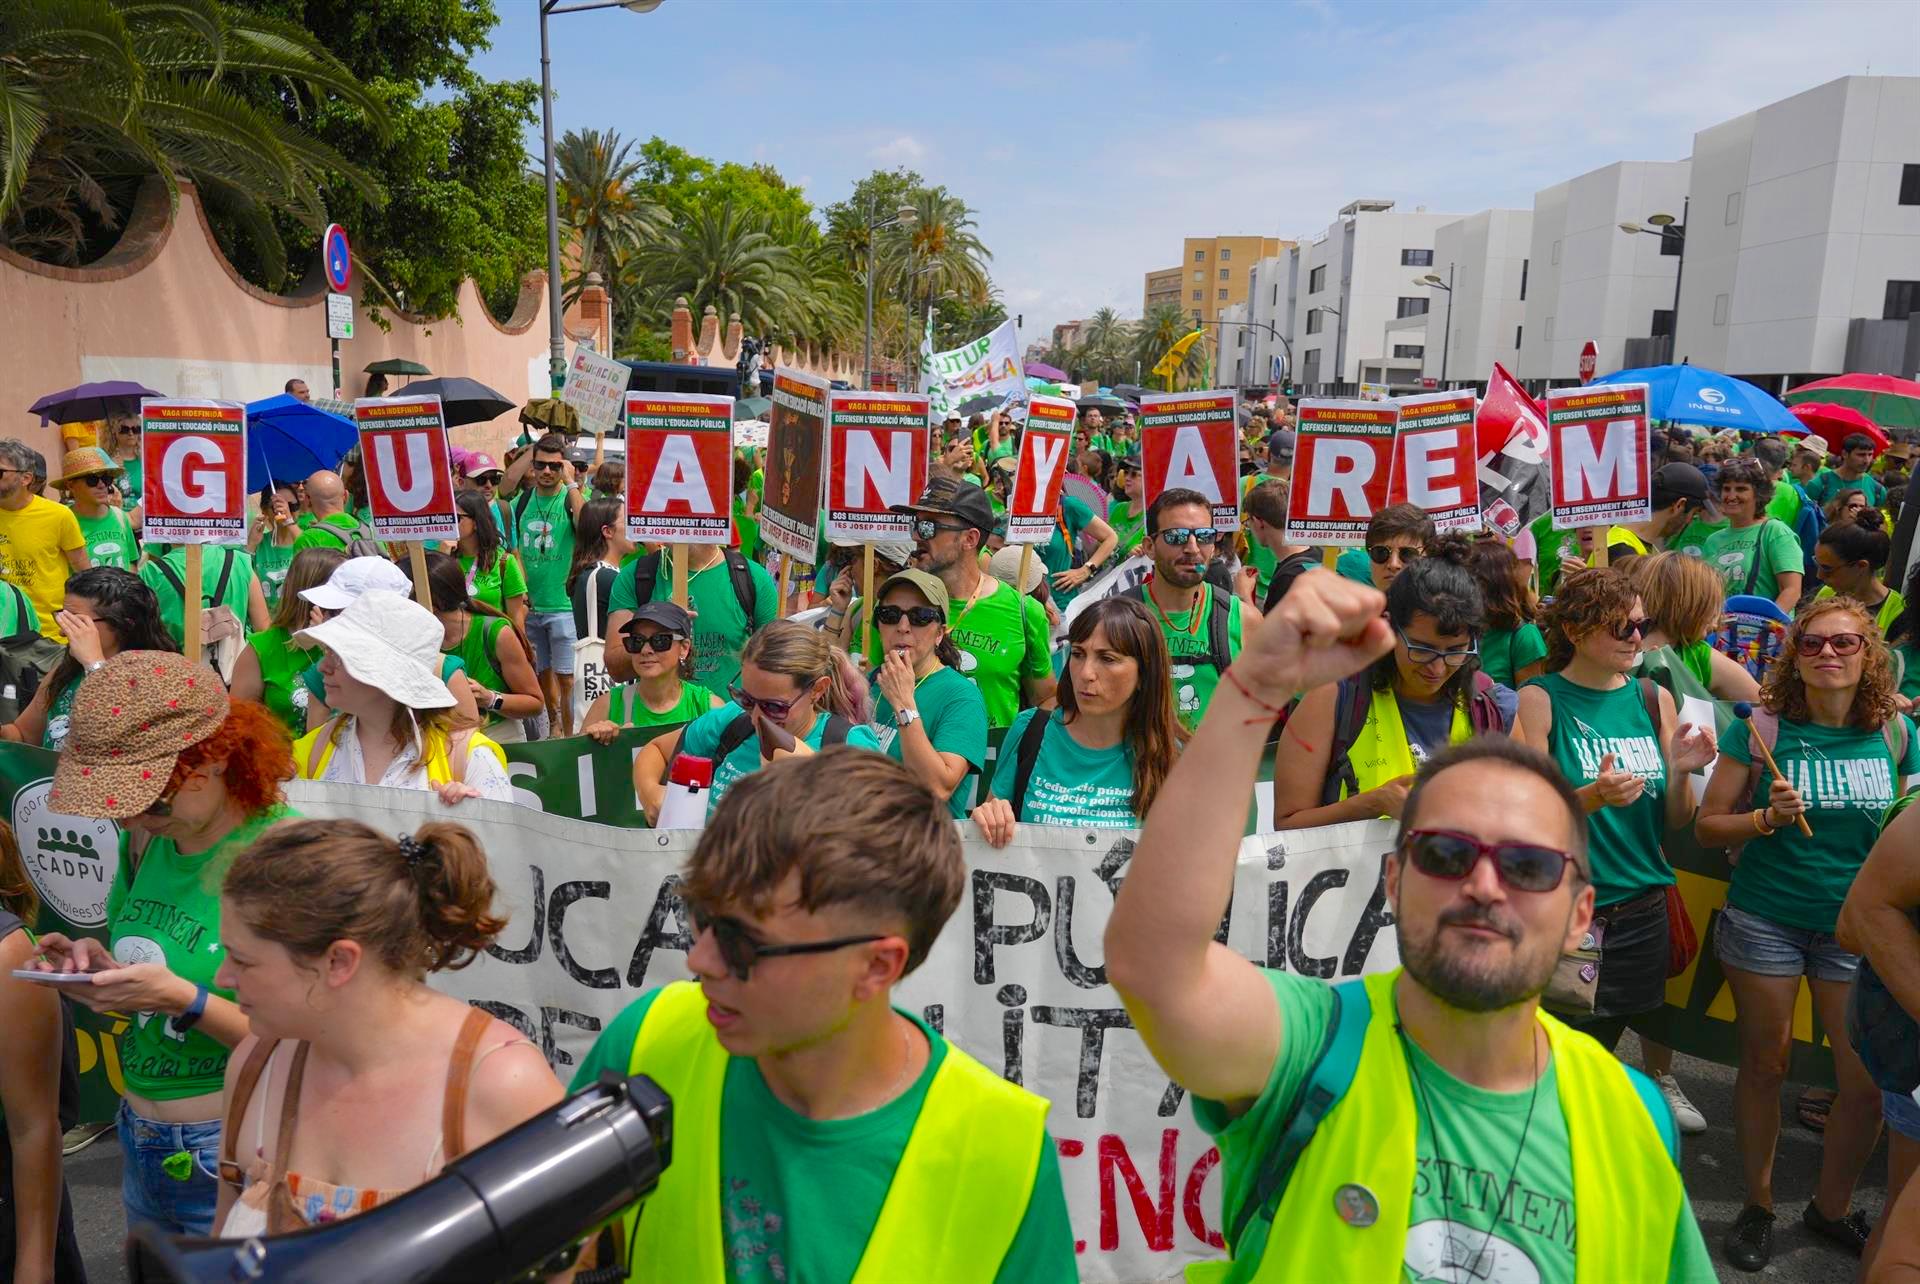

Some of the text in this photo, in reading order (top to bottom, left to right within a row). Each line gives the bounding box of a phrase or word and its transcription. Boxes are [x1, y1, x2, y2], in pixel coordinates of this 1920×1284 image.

[1580, 355, 1596, 371] STOP
[1157, 401, 1217, 412] VAGA INDEFINIDA
[1566, 395, 1626, 406] VAGA INDEFINIDA
[369, 406, 424, 416] VAGA INDEFINIDA
[647, 404, 710, 414] VAGA INDEFINIDA
[869, 403, 911, 412] INDEFINIDA
[1401, 403, 1457, 416] VAGA INDEFINIDA
[1553, 404, 1641, 421] DEFENSEM L'EDUCACIÓ PÚBLICA
[1689, 402, 1742, 415] INESIS
[182, 410, 222, 418] INDEFINIDA
[1144, 410, 1231, 425] DEFENSEM L'EDUCACIÓ PÚBLICA
[1318, 411, 1378, 420] VAGA INDEFINIDA
[148, 421, 239, 432] DEFENSEM L'EDUCACIÓ PÚBLICA
[360, 416, 439, 429] DEFENSEM L'EDUCACIÓ PÚBLICA
[632, 417, 726, 428] DEFENSEM L'EDUCACIÓ PÚBLICA
[835, 415, 924, 426] DEFENSEM L'EDUCACIÓ PÚBLICA
[1399, 413, 1470, 430] ENSEM L'EDUCACIÓ PÚBLICA
[1302, 422, 1392, 434] DEFENSEM L'EDUCACIÓ PÚBLICA
[1163, 426, 1224, 504] A
[1560, 420, 1638, 502] M
[162, 436, 226, 514] G
[374, 433, 434, 512] U
[642, 434, 716, 513] A
[845, 430, 912, 510] N
[1033, 436, 1064, 512] Y
[1404, 429, 1461, 509] E
[1307, 438, 1376, 517] R
[1213, 506, 1235, 515] PÚBLIC
[1454, 507, 1476, 517] PÚBLIC
[1556, 499, 1646, 516] SOS ENSENYAMENT PÚBLIC
[375, 514, 453, 526] SOS ENSENYAMENT PÚBLIC
[848, 513, 895, 522] ENSENYAMENT
[1215, 517, 1234, 525] BERA
[1574, 514, 1598, 522] JOSEP
[1616, 509, 1644, 518] RIBERA
[165, 519, 214, 527] ENSENYAMENT
[216, 518, 240, 527] PÚBLIC
[630, 517, 726, 527] SOS ENSENYAMENT PÚBLIC
[1306, 521, 1356, 530] ENSENYAMENT
[1450, 517, 1475, 527] RIBERA
[208, 529, 239, 537] RIBERA
[584, 677, 598, 690] IS
[1633, 771, 1664, 779] OCA
[1787, 758, 1894, 801] LA LLENGUA
[1096, 787, 1135, 797] públi
[1089, 797, 1131, 807] polític
[1821, 801, 1845, 809] ES
[1852, 801, 1888, 809] TOC
[1028, 799, 1136, 818] més revolucionàr
[1034, 814, 1040, 822] a
[1042, 813, 1074, 827] llarg
[37, 853, 104, 883] CADPV
[1413, 1157, 1577, 1255] STIMEM
